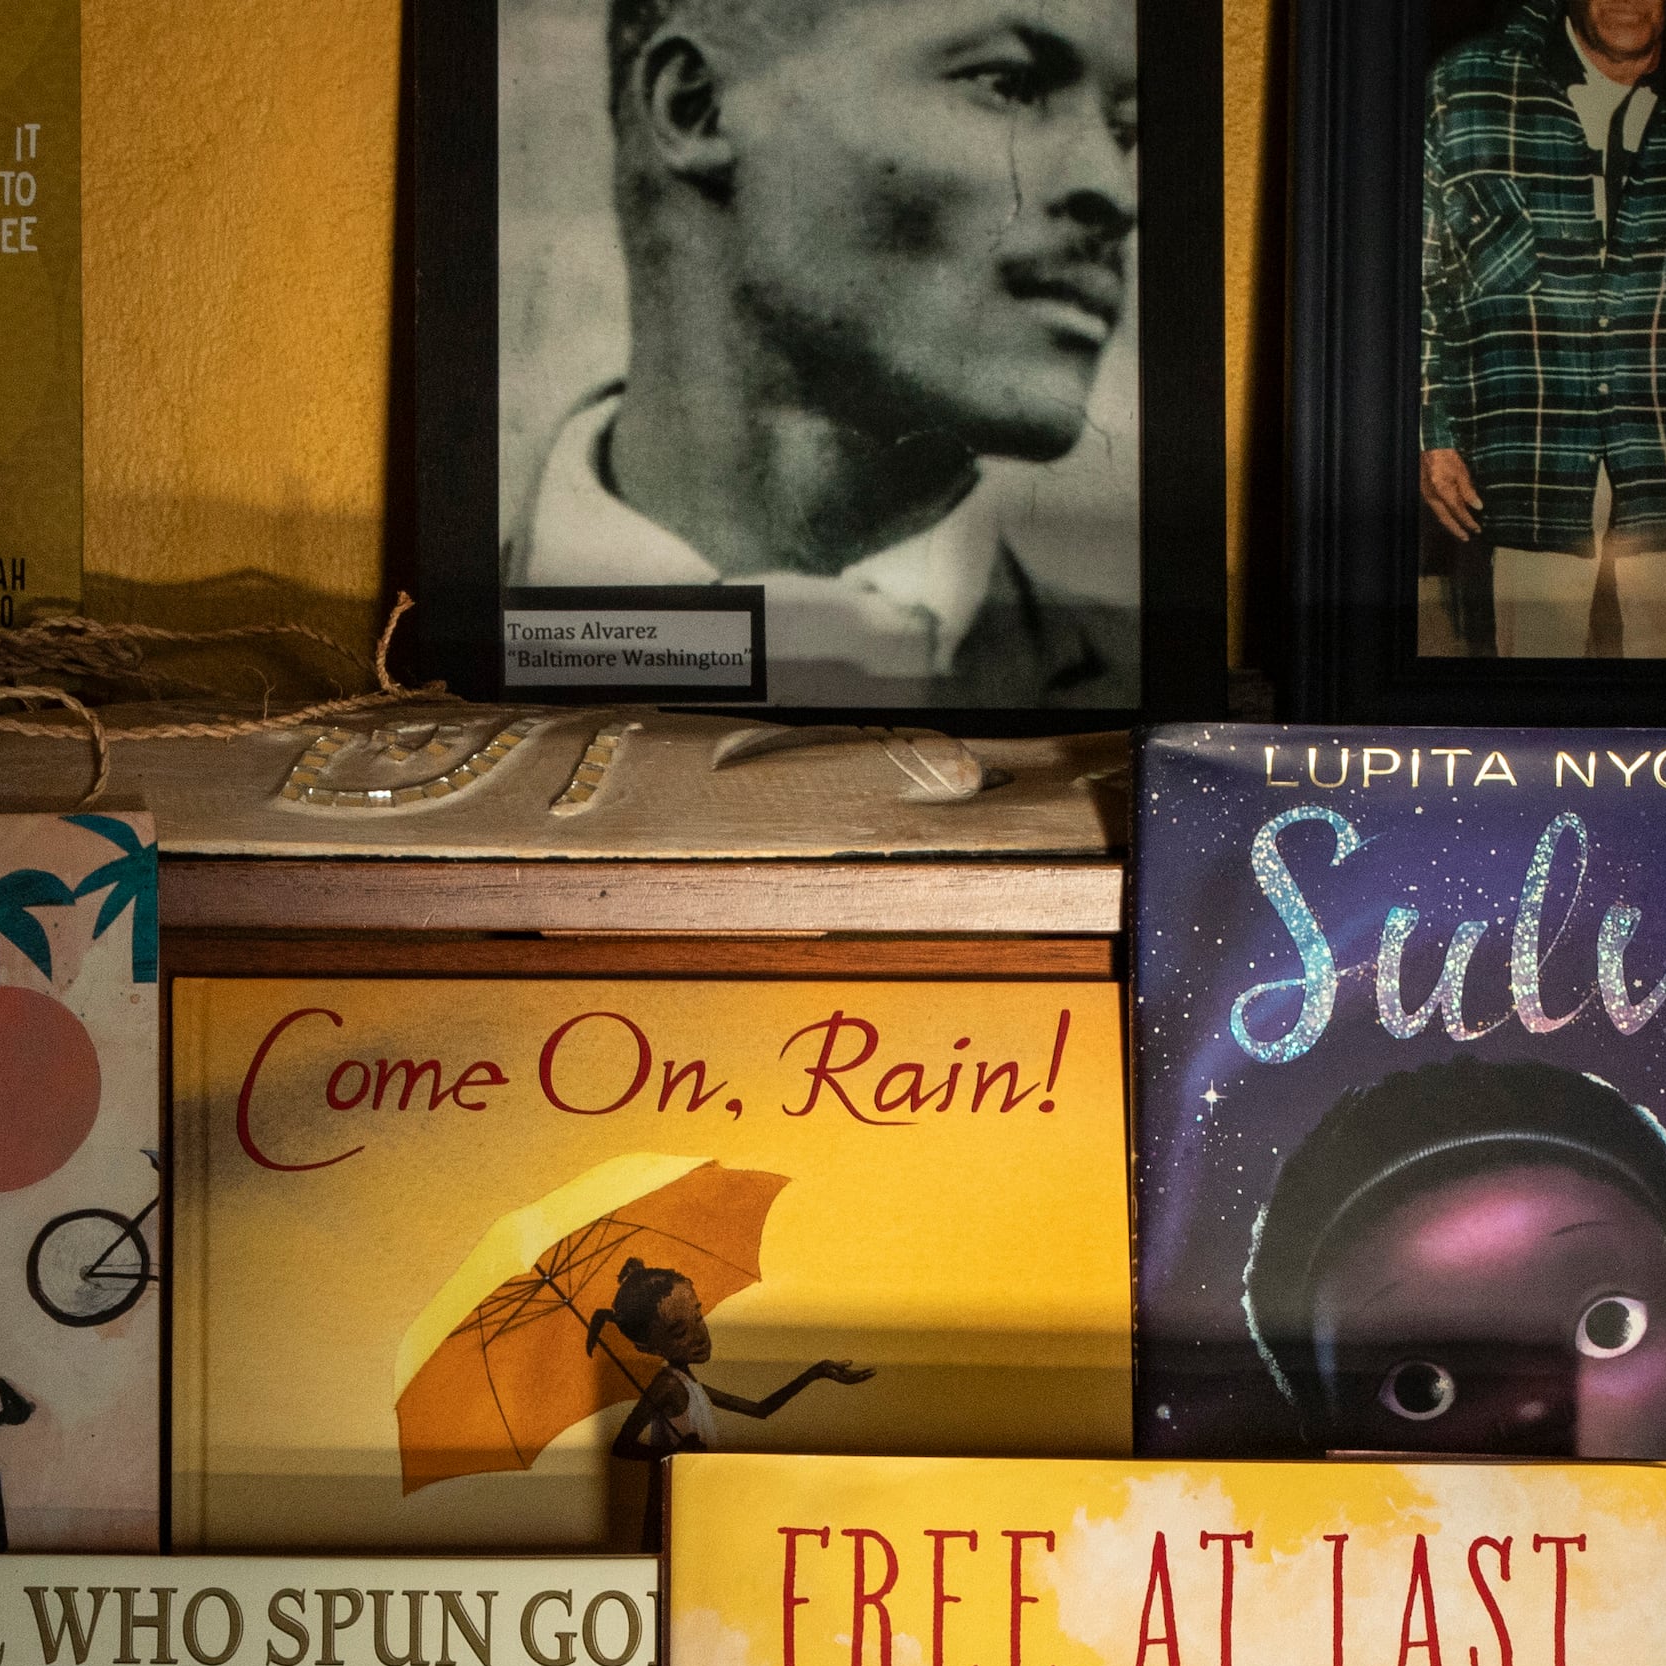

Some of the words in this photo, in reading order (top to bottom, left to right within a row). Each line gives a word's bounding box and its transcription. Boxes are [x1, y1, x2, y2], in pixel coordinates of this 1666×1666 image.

[15, 124, 40, 160] IT
[0, 170, 38, 206] TO
[507, 622, 574, 641] Tomas
[581, 621, 657, 641] Alvarez
[1264, 747, 1519, 788] LUPITA
[236, 1008, 509, 1171] Come
[539, 1012, 744, 1120] On,
[780, 1009, 1071, 1126] Rain!
